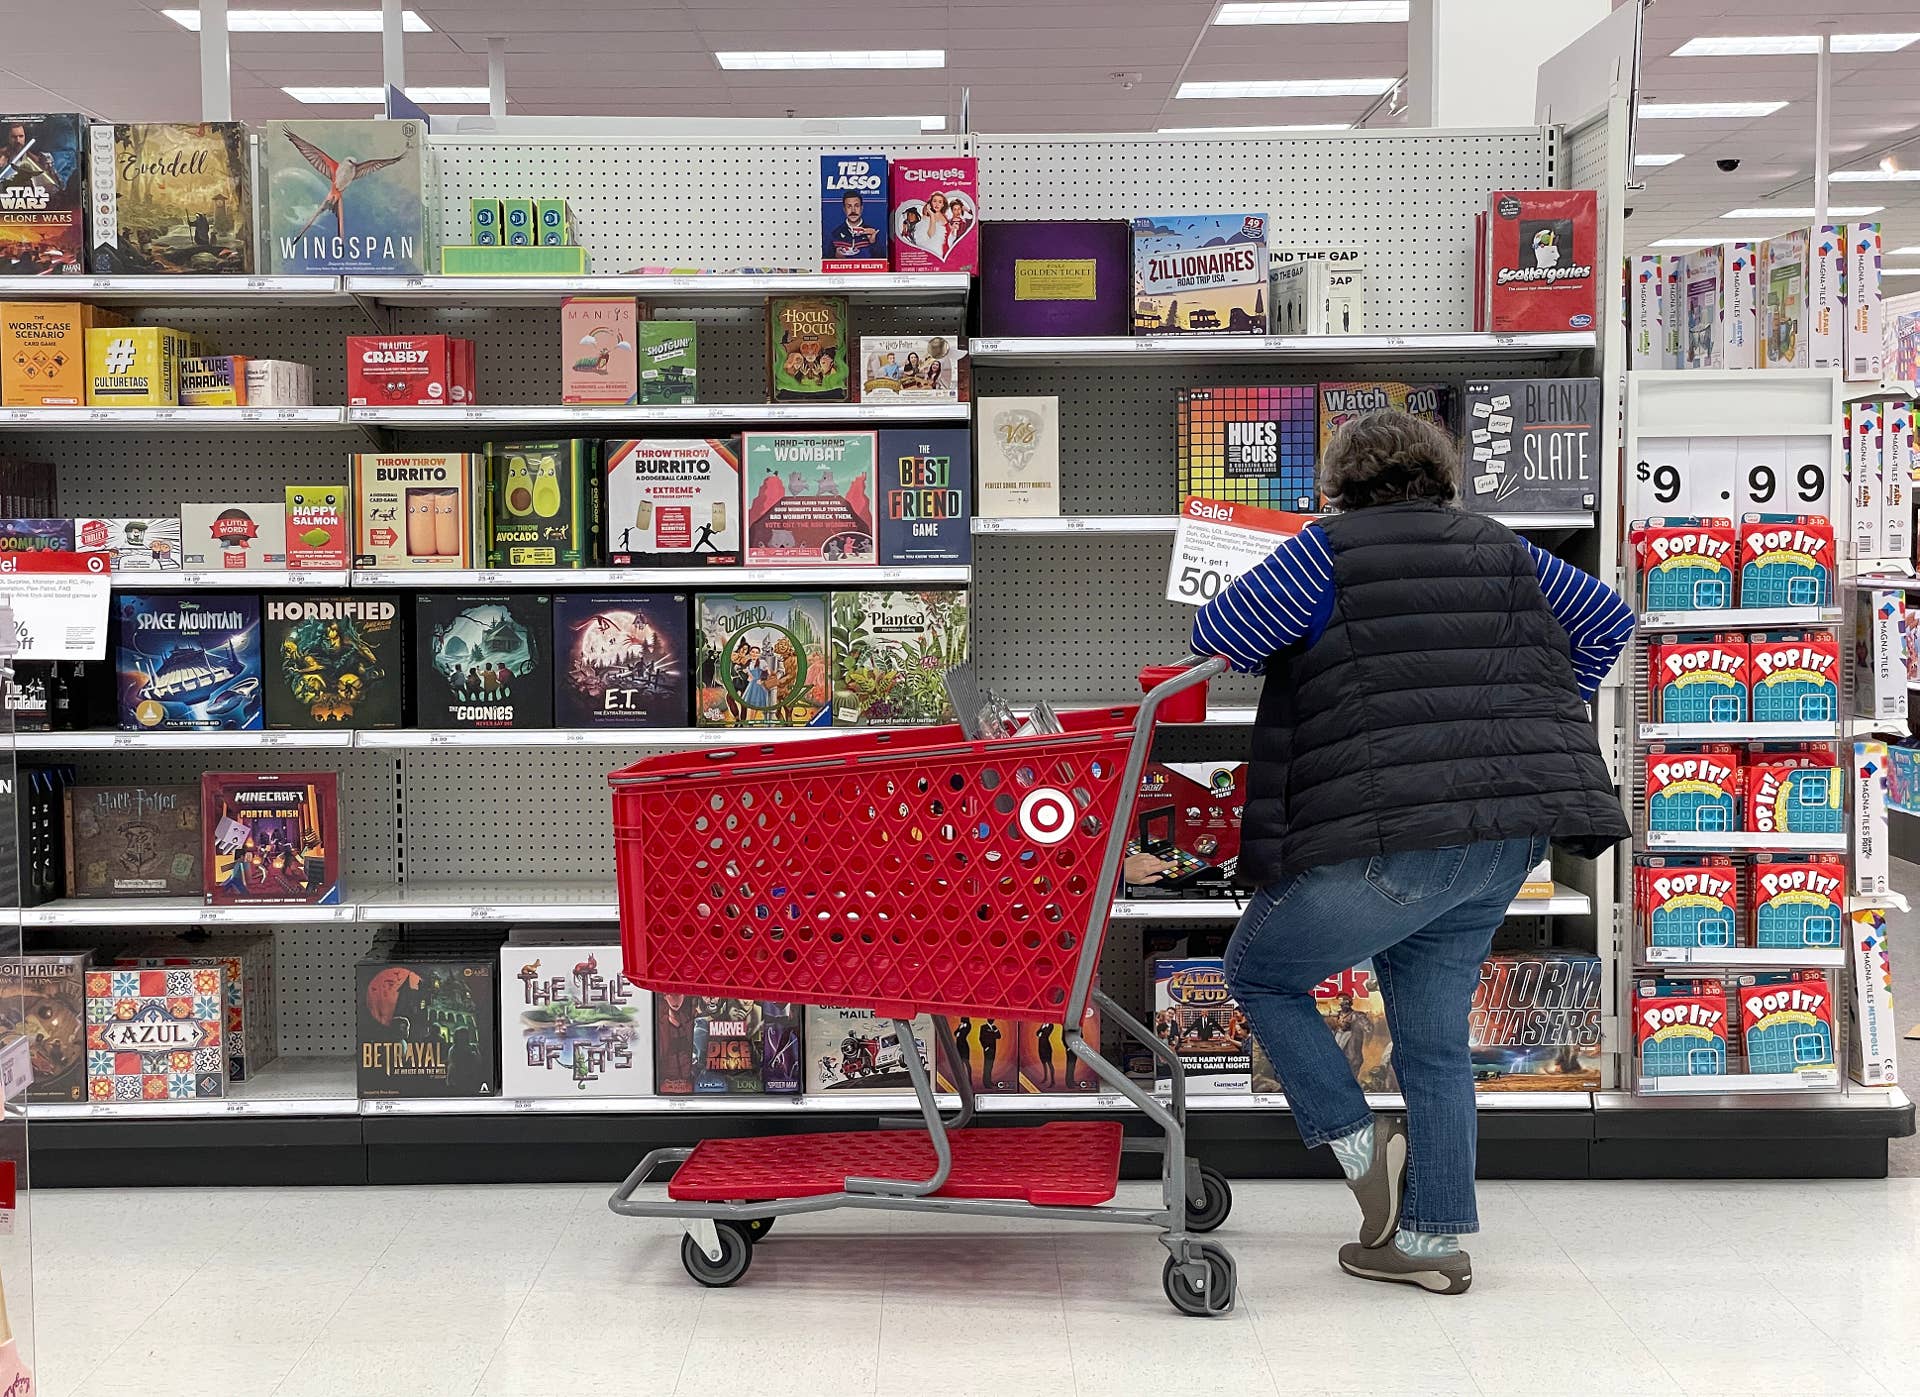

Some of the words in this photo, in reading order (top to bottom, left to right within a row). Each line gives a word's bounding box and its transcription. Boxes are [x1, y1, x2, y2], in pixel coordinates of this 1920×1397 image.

[120, 151, 208, 181] Everdell
[837, 162, 869, 175] TED
[827, 175, 881, 190] LASSO
[4, 214, 37, 223] CLONE
[42, 214, 72, 223] WARS
[1247, 219, 1260, 227] 49
[280, 237, 413, 259] WINGSPAN
[1060, 268, 1090, 276] TICKET
[1149, 250, 1255, 282] ZILLIONAIRES
[1498, 264, 1591, 284] Scattergories
[1177, 276, 1195, 287] ROAD
[1196, 275, 1211, 285] TRIP
[1213, 274, 1225, 283] USA
[1819, 257, 1827, 306] MAGNA-TILES
[782, 309, 829, 325] HOCUS
[8, 322, 71, 331] WORST-CASE
[792, 322, 836, 337] POCUS
[15, 331, 65, 339] SCENARIO
[104, 338, 136, 374] #
[363, 351, 429, 364] CRABBY
[181, 359, 228, 373] KULTURE
[95, 377, 148, 387] CULTURETAGS
[181, 374, 230, 388] KARAOKE
[1326, 388, 1386, 411] Watch
[1408, 388, 1437, 414] 200
[1525, 384, 1587, 423] BLANK
[1228, 422, 1278, 446] HUES
[636, 450, 671, 458] THROW
[672, 450, 710, 458] THROW
[775, 447, 845, 462] WOMBAT
[918, 445, 930, 454] THE
[1229, 446, 1241, 463] AND
[1242, 446, 1278, 464] CUES
[1523, 432, 1589, 480] SLATE
[1891, 433, 1899, 482] MAGNA-TILES
[376, 458, 411, 466] THROW
[412, 458, 446, 466] THROW
[636, 460, 711, 474] BURRITO
[376, 468, 447, 481] BURRITO
[901, 458, 948, 486] BEST
[653, 486, 693, 494] EXTREME
[293, 506, 336, 517] HAPPY
[890, 491, 961, 519] FRIEND
[1189, 500, 1234, 521] Sale!
[293, 517, 338, 526] SALMON
[85, 531, 105, 542] TROLLEY
[496, 532, 539, 542] AVOCADO
[912, 524, 938, 537] GAME
[1652, 535, 1697, 560] POP
[1698, 533, 1731, 559] IT!
[1746, 531, 1793, 555] POP
[1793, 531, 1827, 555] IT!
[1182, 553, 1198, 563] Buy
[1209, 559, 1222, 567] get
[179, 601, 200, 611] Disney
[267, 602, 396, 621] HORRIFIED
[137, 611, 176, 630] SPACE
[179, 610, 243, 630] MOUNTAIN
[718, 605, 767, 633] WIZARD
[868, 611, 925, 626] Planted
[1727, 635, 1742, 643] 3-10
[1880, 621, 1889, 679] MAGNA-TILES
[1665, 650, 1711, 677] POP
[1711, 649, 1745, 674] IT!
[1755, 649, 1800, 676] POP
[1801, 648, 1835, 673] IT!
[5, 681, 22, 694] The
[5, 695, 47, 710] Godfather
[604, 688, 638, 710] E.T.
[1652, 760, 1698, 786] POP
[1698, 759, 1732, 785] IT!
[136, 789, 176, 810] Potter
[235, 791, 304, 802] MINECRAFT
[240, 810, 273, 819] PORTAL
[275, 809, 299, 818] DASH
[1714, 858, 1729, 866] 3-10
[1653, 874, 1698, 900] POP
[1699, 873, 1733, 899] IT!
[1760, 871, 1806, 896] POP
[1807, 870, 1840, 895] IT!
[1804, 972, 1820, 980] 3-10
[1864, 952, 1875, 1004] MAGNA-TILES
[517, 973, 567, 1006] THE
[573, 969, 632, 1009] ISLE
[1471, 961, 1601, 1009] STORM
[1182, 986, 1228, 1003] FEUD
[1745, 991, 1790, 1019] POP
[1792, 989, 1825, 1013] IT!
[840, 1010, 867, 1019] MAIL
[1643, 1004, 1688, 1031] POP
[1689, 1004, 1722, 1028] IT!
[120, 1026, 187, 1045] AZUL
[709, 1021, 746, 1036] MARVEL
[1468, 1009, 1601, 1046] CHASERS
[1868, 1005, 1880, 1057] METROPOLIS
[708, 1041, 749, 1056] DICE
[363, 1042, 445, 1076] BETRAYAL
[527, 1041, 562, 1069] OF
[573, 1038, 632, 1080] CATS
[737, 1079, 757, 1089] LOKI
